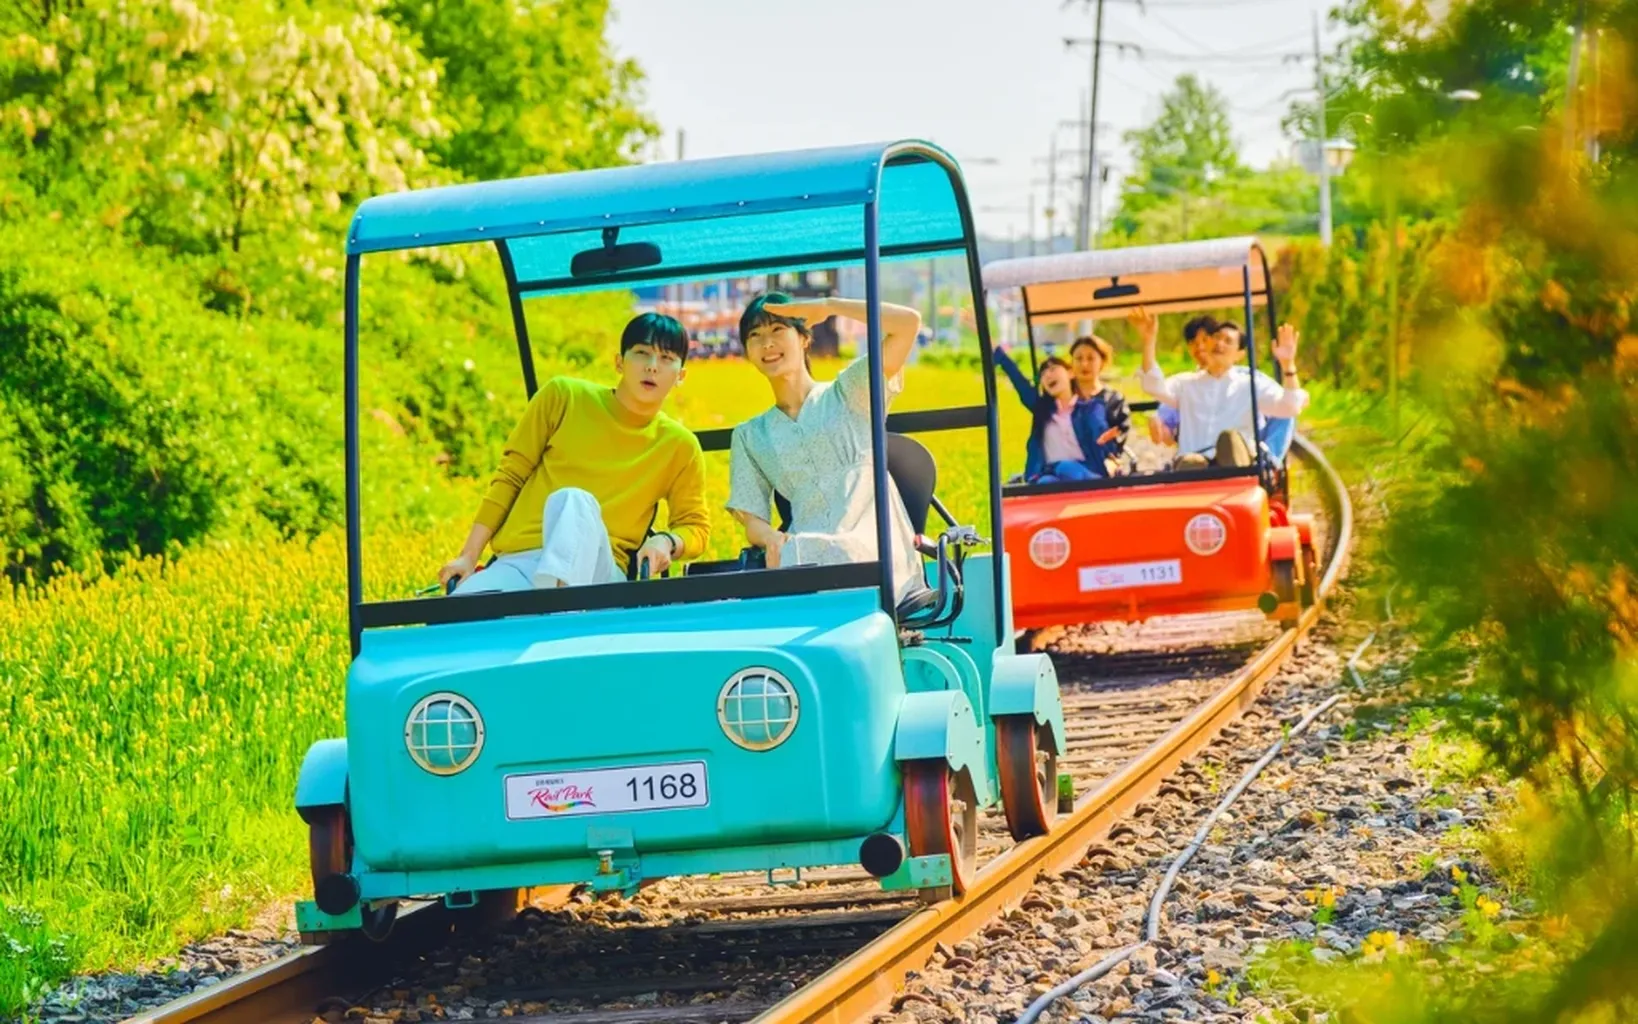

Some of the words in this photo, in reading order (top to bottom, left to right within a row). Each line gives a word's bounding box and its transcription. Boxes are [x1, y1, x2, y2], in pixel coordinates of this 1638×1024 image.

[1140, 565, 1175, 581] 1131
[527, 787, 560, 806] Rail
[562, 785, 594, 802] Park
[626, 773, 697, 802] 1168
